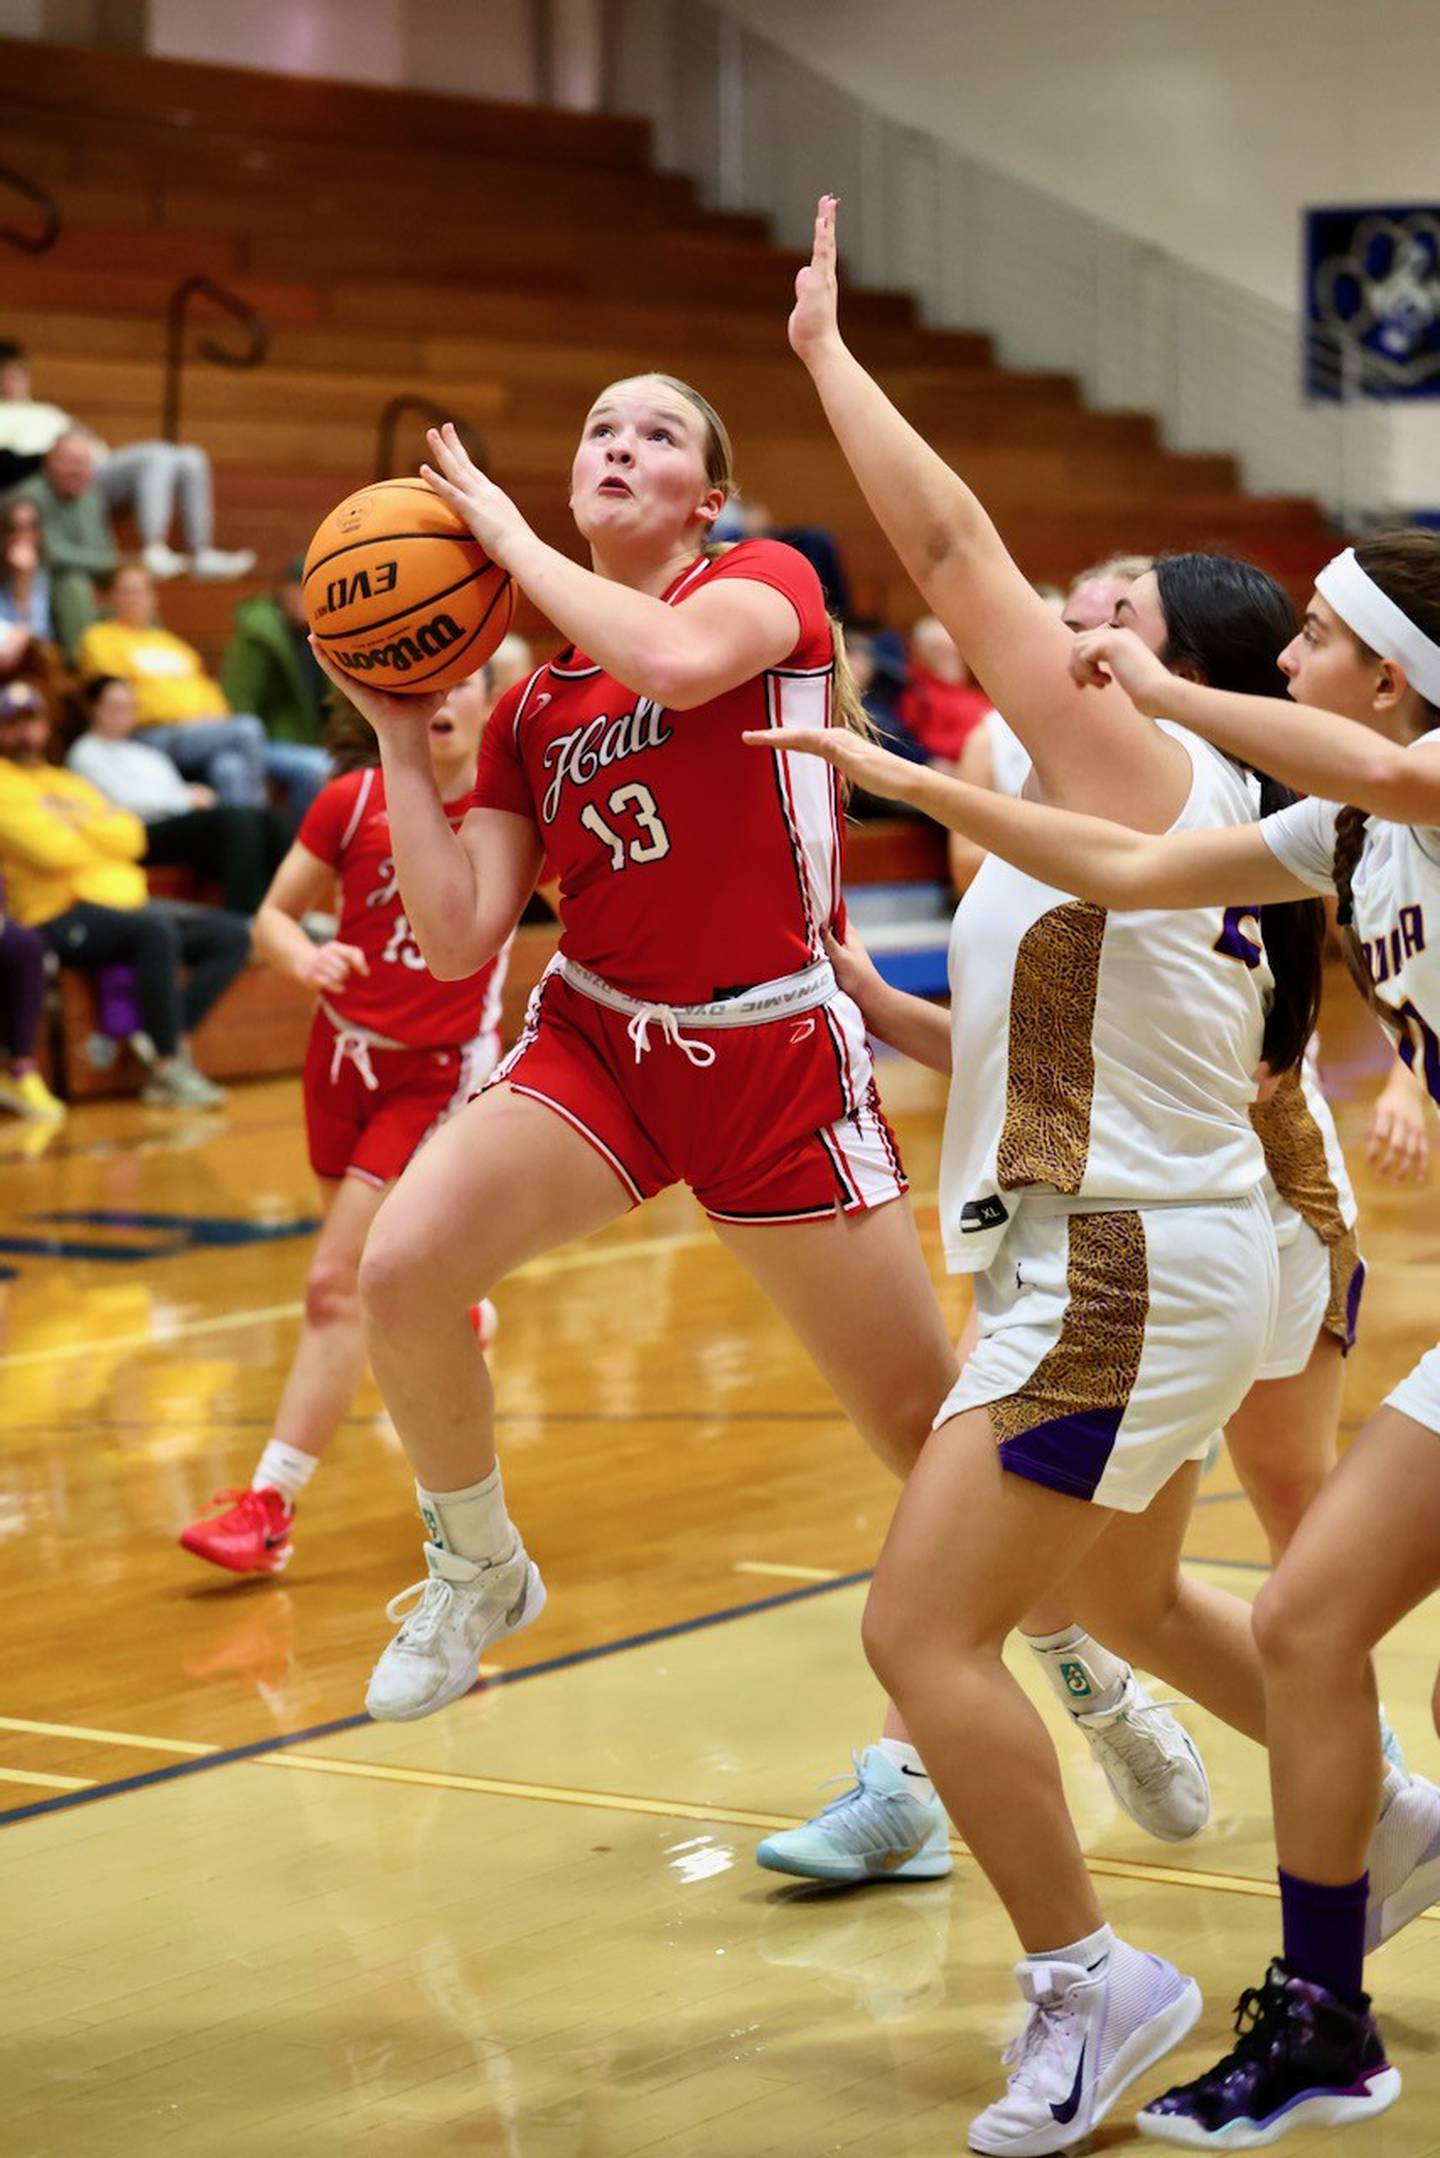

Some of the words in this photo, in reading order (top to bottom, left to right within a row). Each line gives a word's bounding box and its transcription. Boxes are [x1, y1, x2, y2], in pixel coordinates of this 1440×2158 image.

[327, 561, 398, 613] EVO
[332, 614, 466, 671] Wilson
[542, 694, 673, 824] Hall
[580, 781, 671, 872] 13
[741, 973, 830, 1013] DYNAMIC
[980, 1206, 1002, 1220] XL
